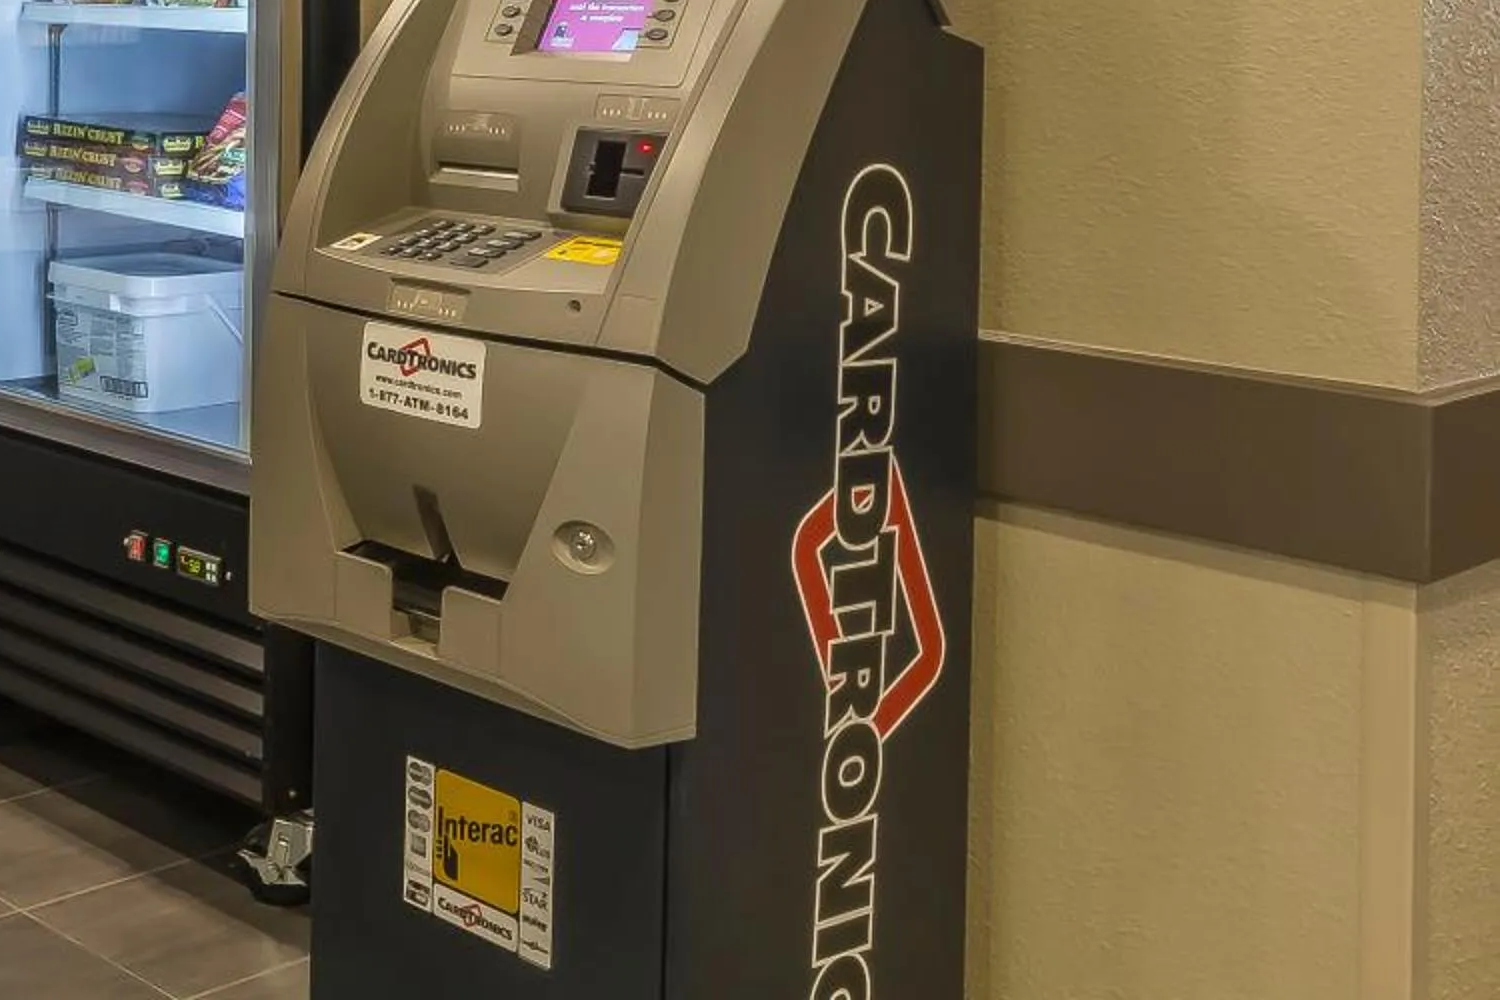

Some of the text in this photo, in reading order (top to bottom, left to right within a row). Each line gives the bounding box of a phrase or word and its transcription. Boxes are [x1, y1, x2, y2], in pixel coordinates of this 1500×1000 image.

[367, 341, 477, 379] CARDTRONICS
[369, 388, 469, 419] 1-877-ATM-8164
[375, 375, 462, 398] www.cardtronics.com
[438, 805, 518, 847] Interac
[437, 896, 512, 940] CARDTRONICS
